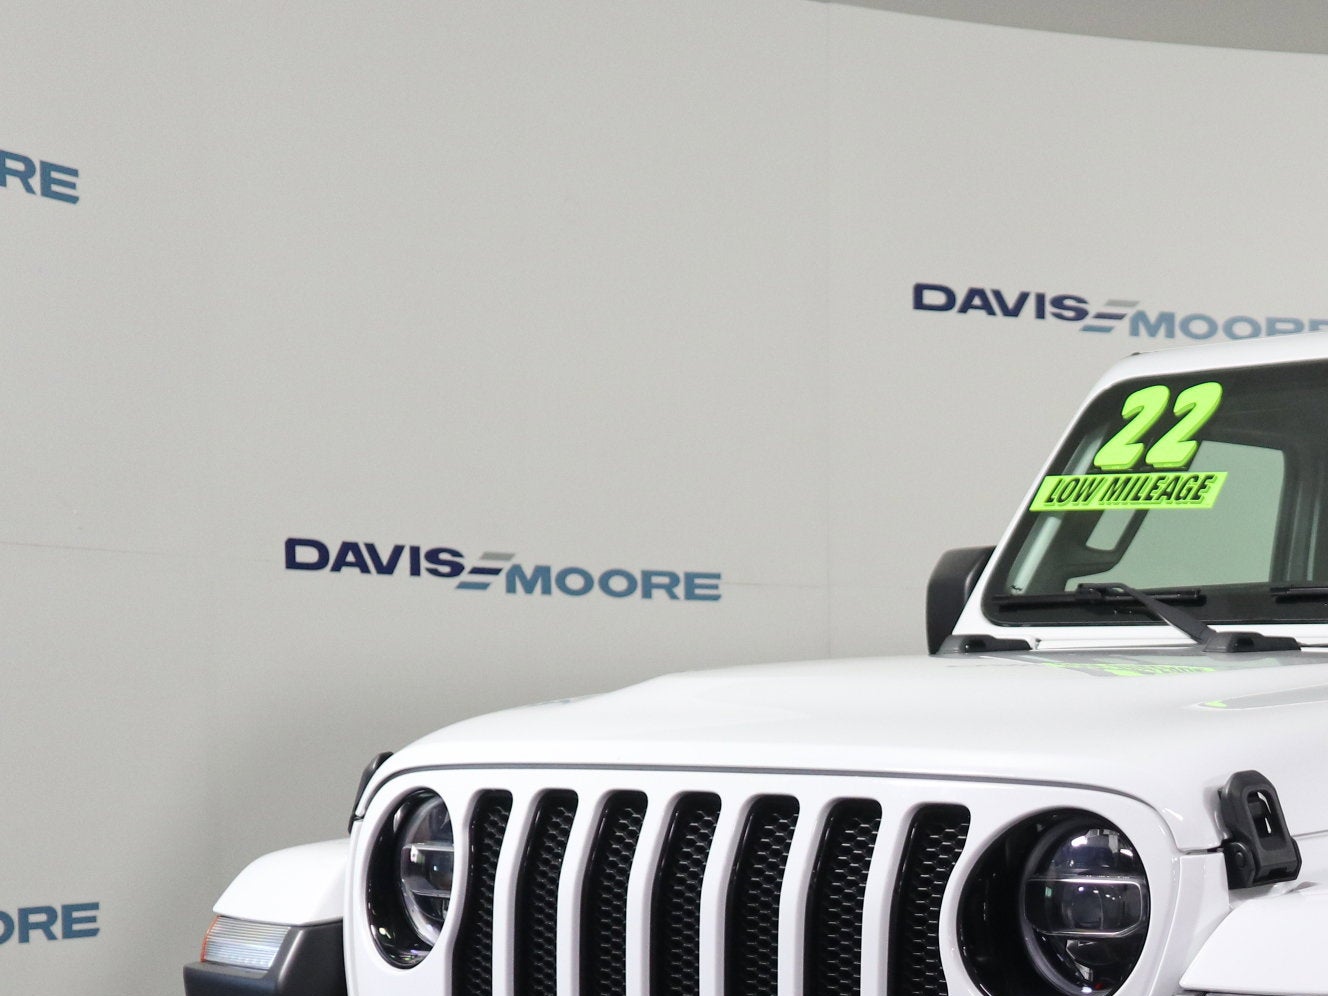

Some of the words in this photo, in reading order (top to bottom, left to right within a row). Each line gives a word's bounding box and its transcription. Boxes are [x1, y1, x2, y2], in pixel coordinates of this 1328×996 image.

[912, 282, 1090, 322] DAVIS
[1094, 381, 1224, 471] 22
[1044, 476, 1104, 506] LOW
[1099, 473, 1217, 505] MILEAGE
[284, 537, 466, 579] DAVIS
[505, 563, 723, 602] MOORE
